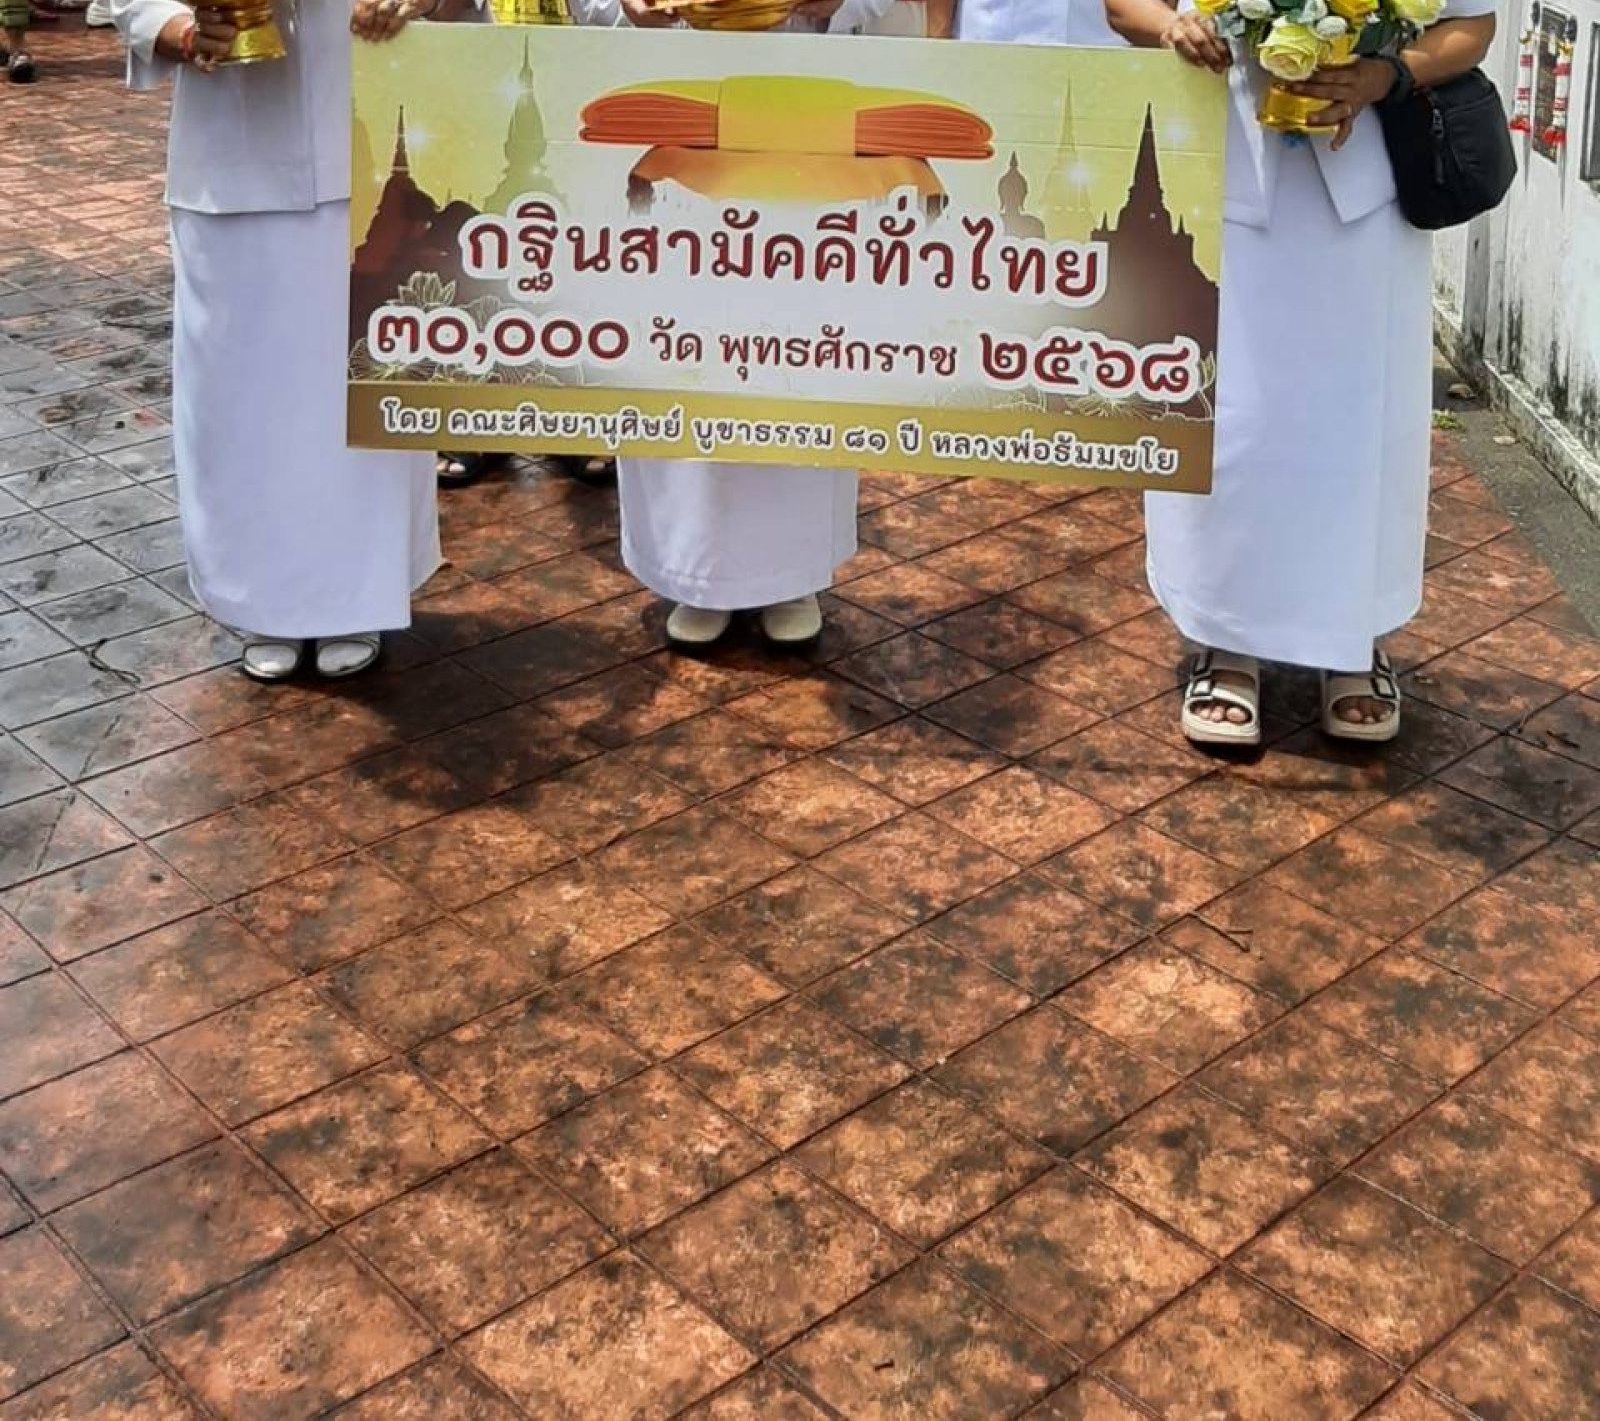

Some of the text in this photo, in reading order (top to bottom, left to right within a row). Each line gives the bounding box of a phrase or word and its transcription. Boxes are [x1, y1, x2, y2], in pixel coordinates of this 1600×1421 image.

[467, 195, 1099, 298] กฐินสามัคคีทั่วไทย
[376, 314, 1190, 393] ๓๐,๐๐๐ วัด พุทธศักราช ๒๕๖๘
[382, 400, 438, 431] โดย
[451, 405, 682, 445] คณะศิษยานุศิษย์
[693, 419, 833, 450] บูชาธรรม
[844, 428, 887, 451] ๘๑
[899, 422, 921, 452] ปี
